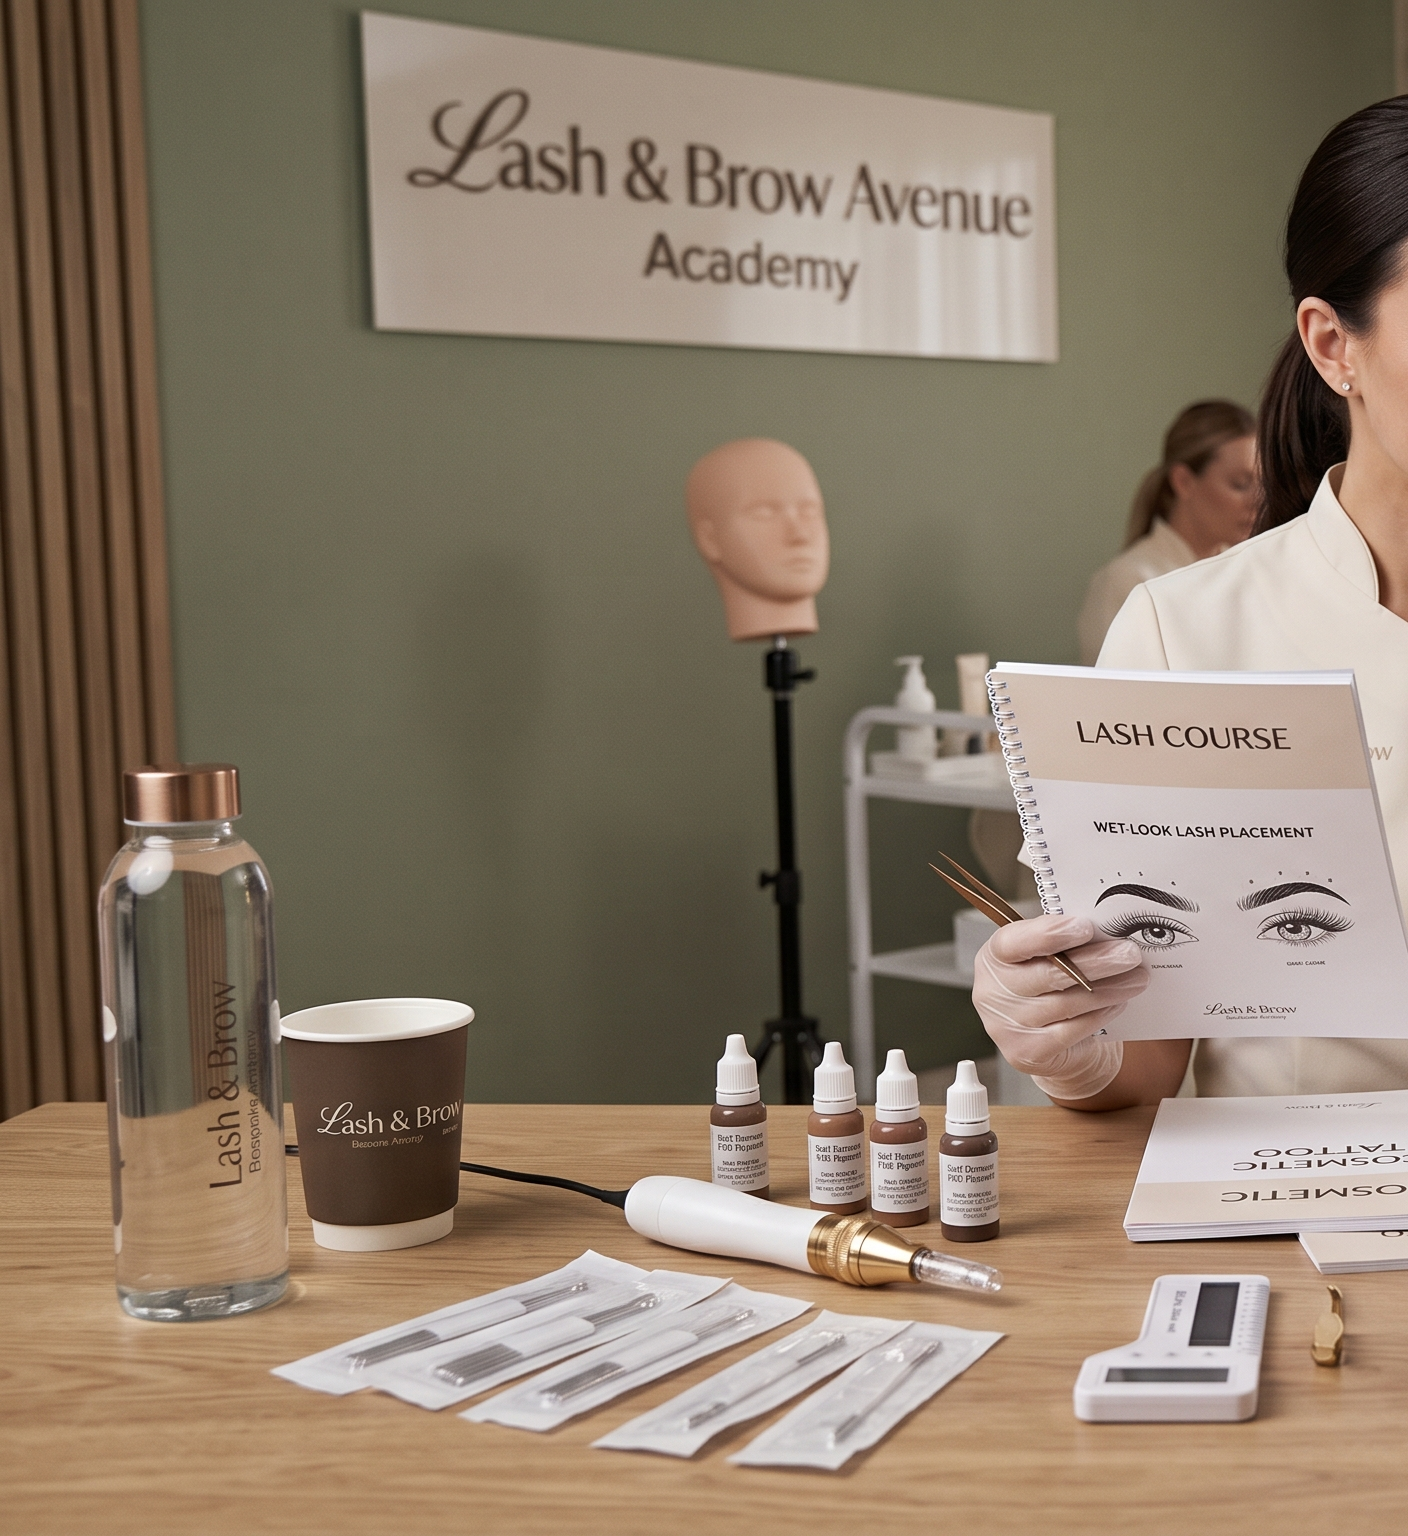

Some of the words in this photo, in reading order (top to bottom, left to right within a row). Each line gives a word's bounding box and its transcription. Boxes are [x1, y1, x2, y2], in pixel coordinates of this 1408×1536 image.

[406, 89, 606, 196] Lash
[622, 138, 670, 203] &
[684, 142, 833, 217] Brow
[843, 163, 1034, 239] Avenue
[641, 231, 860, 302] Academy
[1076, 720, 1155, 747] LASH
[1162, 725, 1292, 750] COURSE
[1093, 820, 1173, 837] WET-LOOK
[1175, 823, 1217, 838] LASH
[1219, 826, 1315, 839] PLACEMENT
[207, 980, 239, 1070] Brow
[1203, 1003, 1243, 1016] Lash
[1259, 1005, 1297, 1014] Brow
[207, 1075, 241, 1102] &
[317, 1101, 384, 1135] Lash
[390, 1110, 411, 1132] &
[417, 1099, 462, 1129] Brow
[207, 1108, 243, 1189] Lash
[1252, 1142, 1406, 1158] TATTOO
